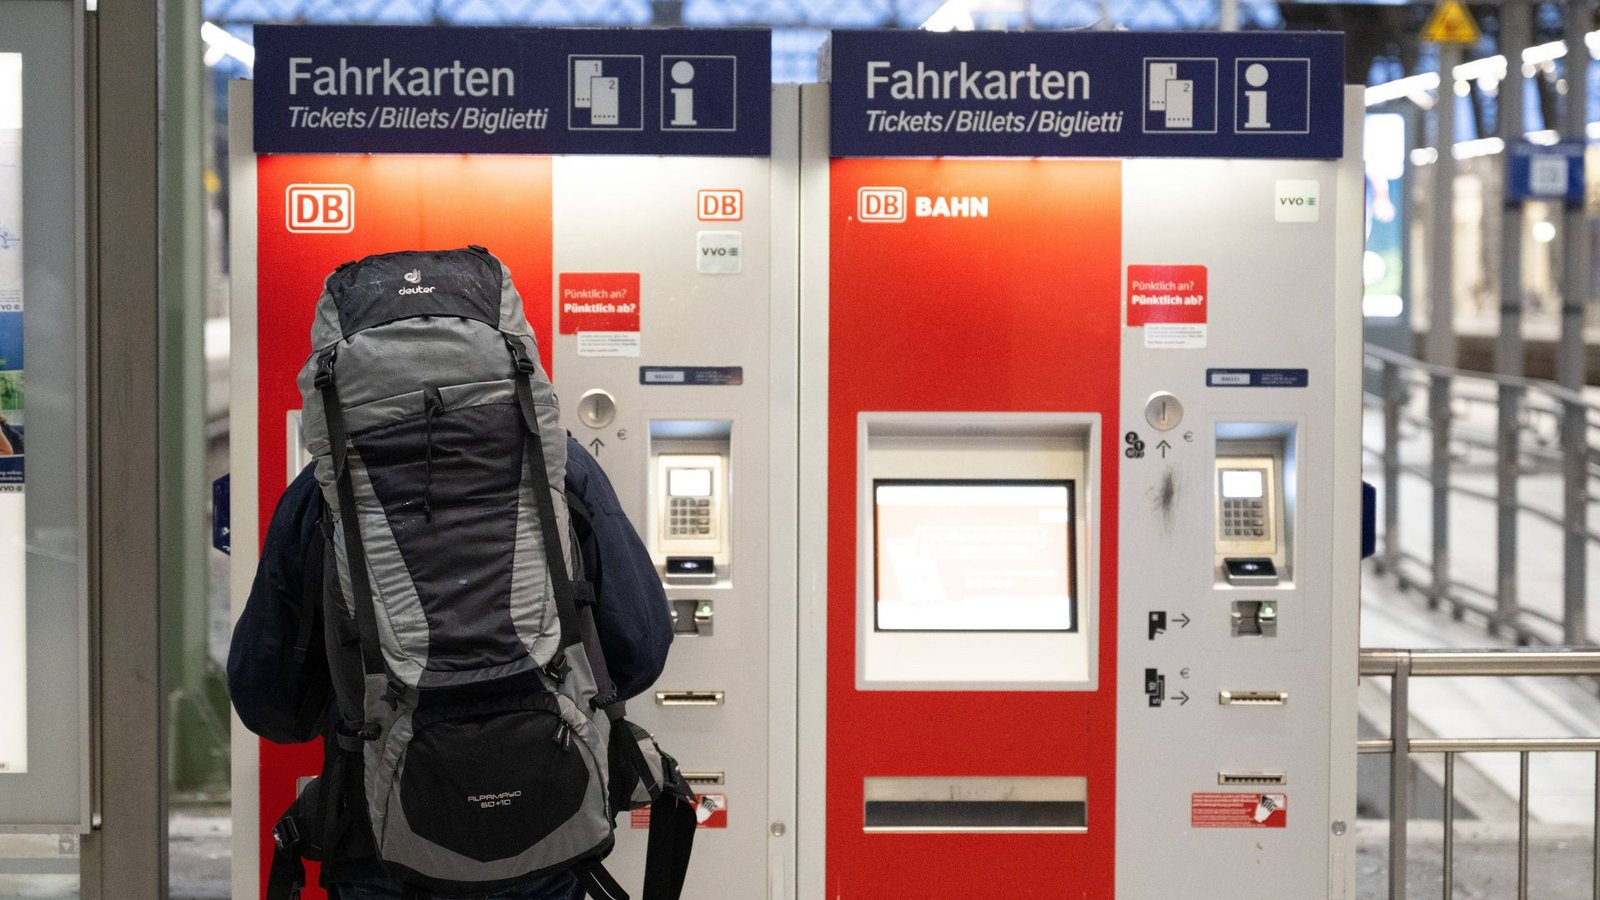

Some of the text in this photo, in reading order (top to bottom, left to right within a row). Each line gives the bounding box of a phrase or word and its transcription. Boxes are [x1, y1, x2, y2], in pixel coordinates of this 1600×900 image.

[289, 57, 515, 97] Fahrkarten
[866, 61, 1091, 101] Fahrkarten
[916, 197, 989, 217] BAHN
[1280, 197, 1304, 206] VVO
[702, 247, 727, 257] VVO
[398, 285, 436, 295] deuter
[1132, 281, 1195, 291] Pünktlich an?
[564, 289, 627, 299] Pünktlich an?
[1132, 295, 1203, 306] Pünktlich ab?
[564, 303, 636, 313] Pünktlich ab?
[617, 429, 628, 440] €
[1183, 431, 1194, 443] €
[1180, 668, 1191, 679] €
[467, 790, 522, 802] ALPAMAYO
